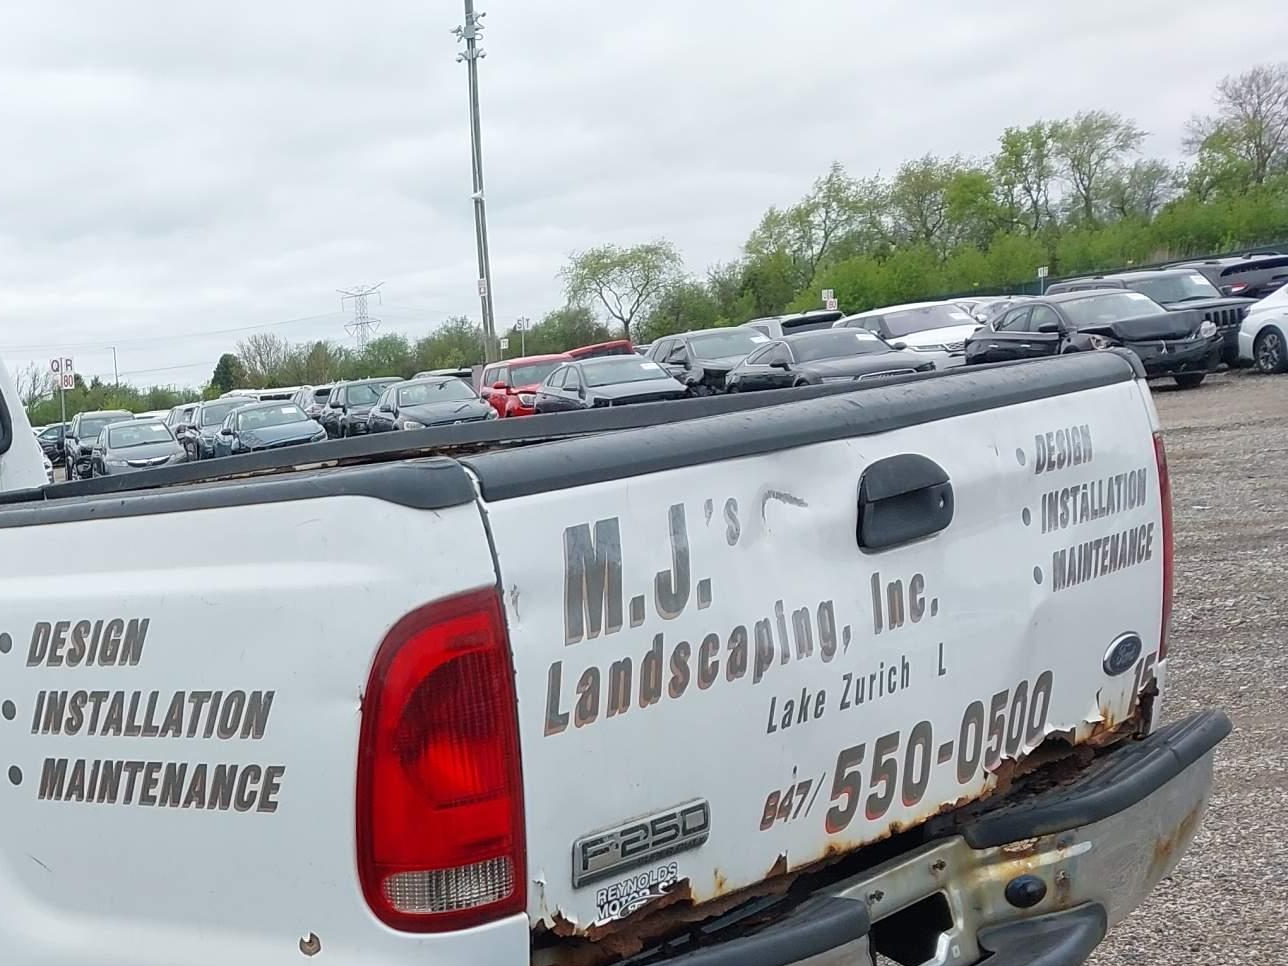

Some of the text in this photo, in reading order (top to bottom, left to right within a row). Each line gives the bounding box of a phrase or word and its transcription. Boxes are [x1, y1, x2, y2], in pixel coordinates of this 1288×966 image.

[50, 358, 73, 373] Q R
[63, 374, 74, 388] 80
[1034, 424, 1093, 475] DESIGN
[1041, 467, 1148, 534] INSTALLATION
[563, 497, 741, 646] M.J.'s
[1052, 522, 1155, 592] MAINTENANCE
[26, 617, 150, 667] DESIGN
[543, 571, 939, 737] Landscaping, Inc.
[31, 690, 275, 740] INSTALLATION
[766, 687, 826, 734] Lake
[839, 655, 910, 711] Zurich
[38, 757, 286, 813] MAINTENANCE
[596, 861, 678, 907] REYNOLDS
